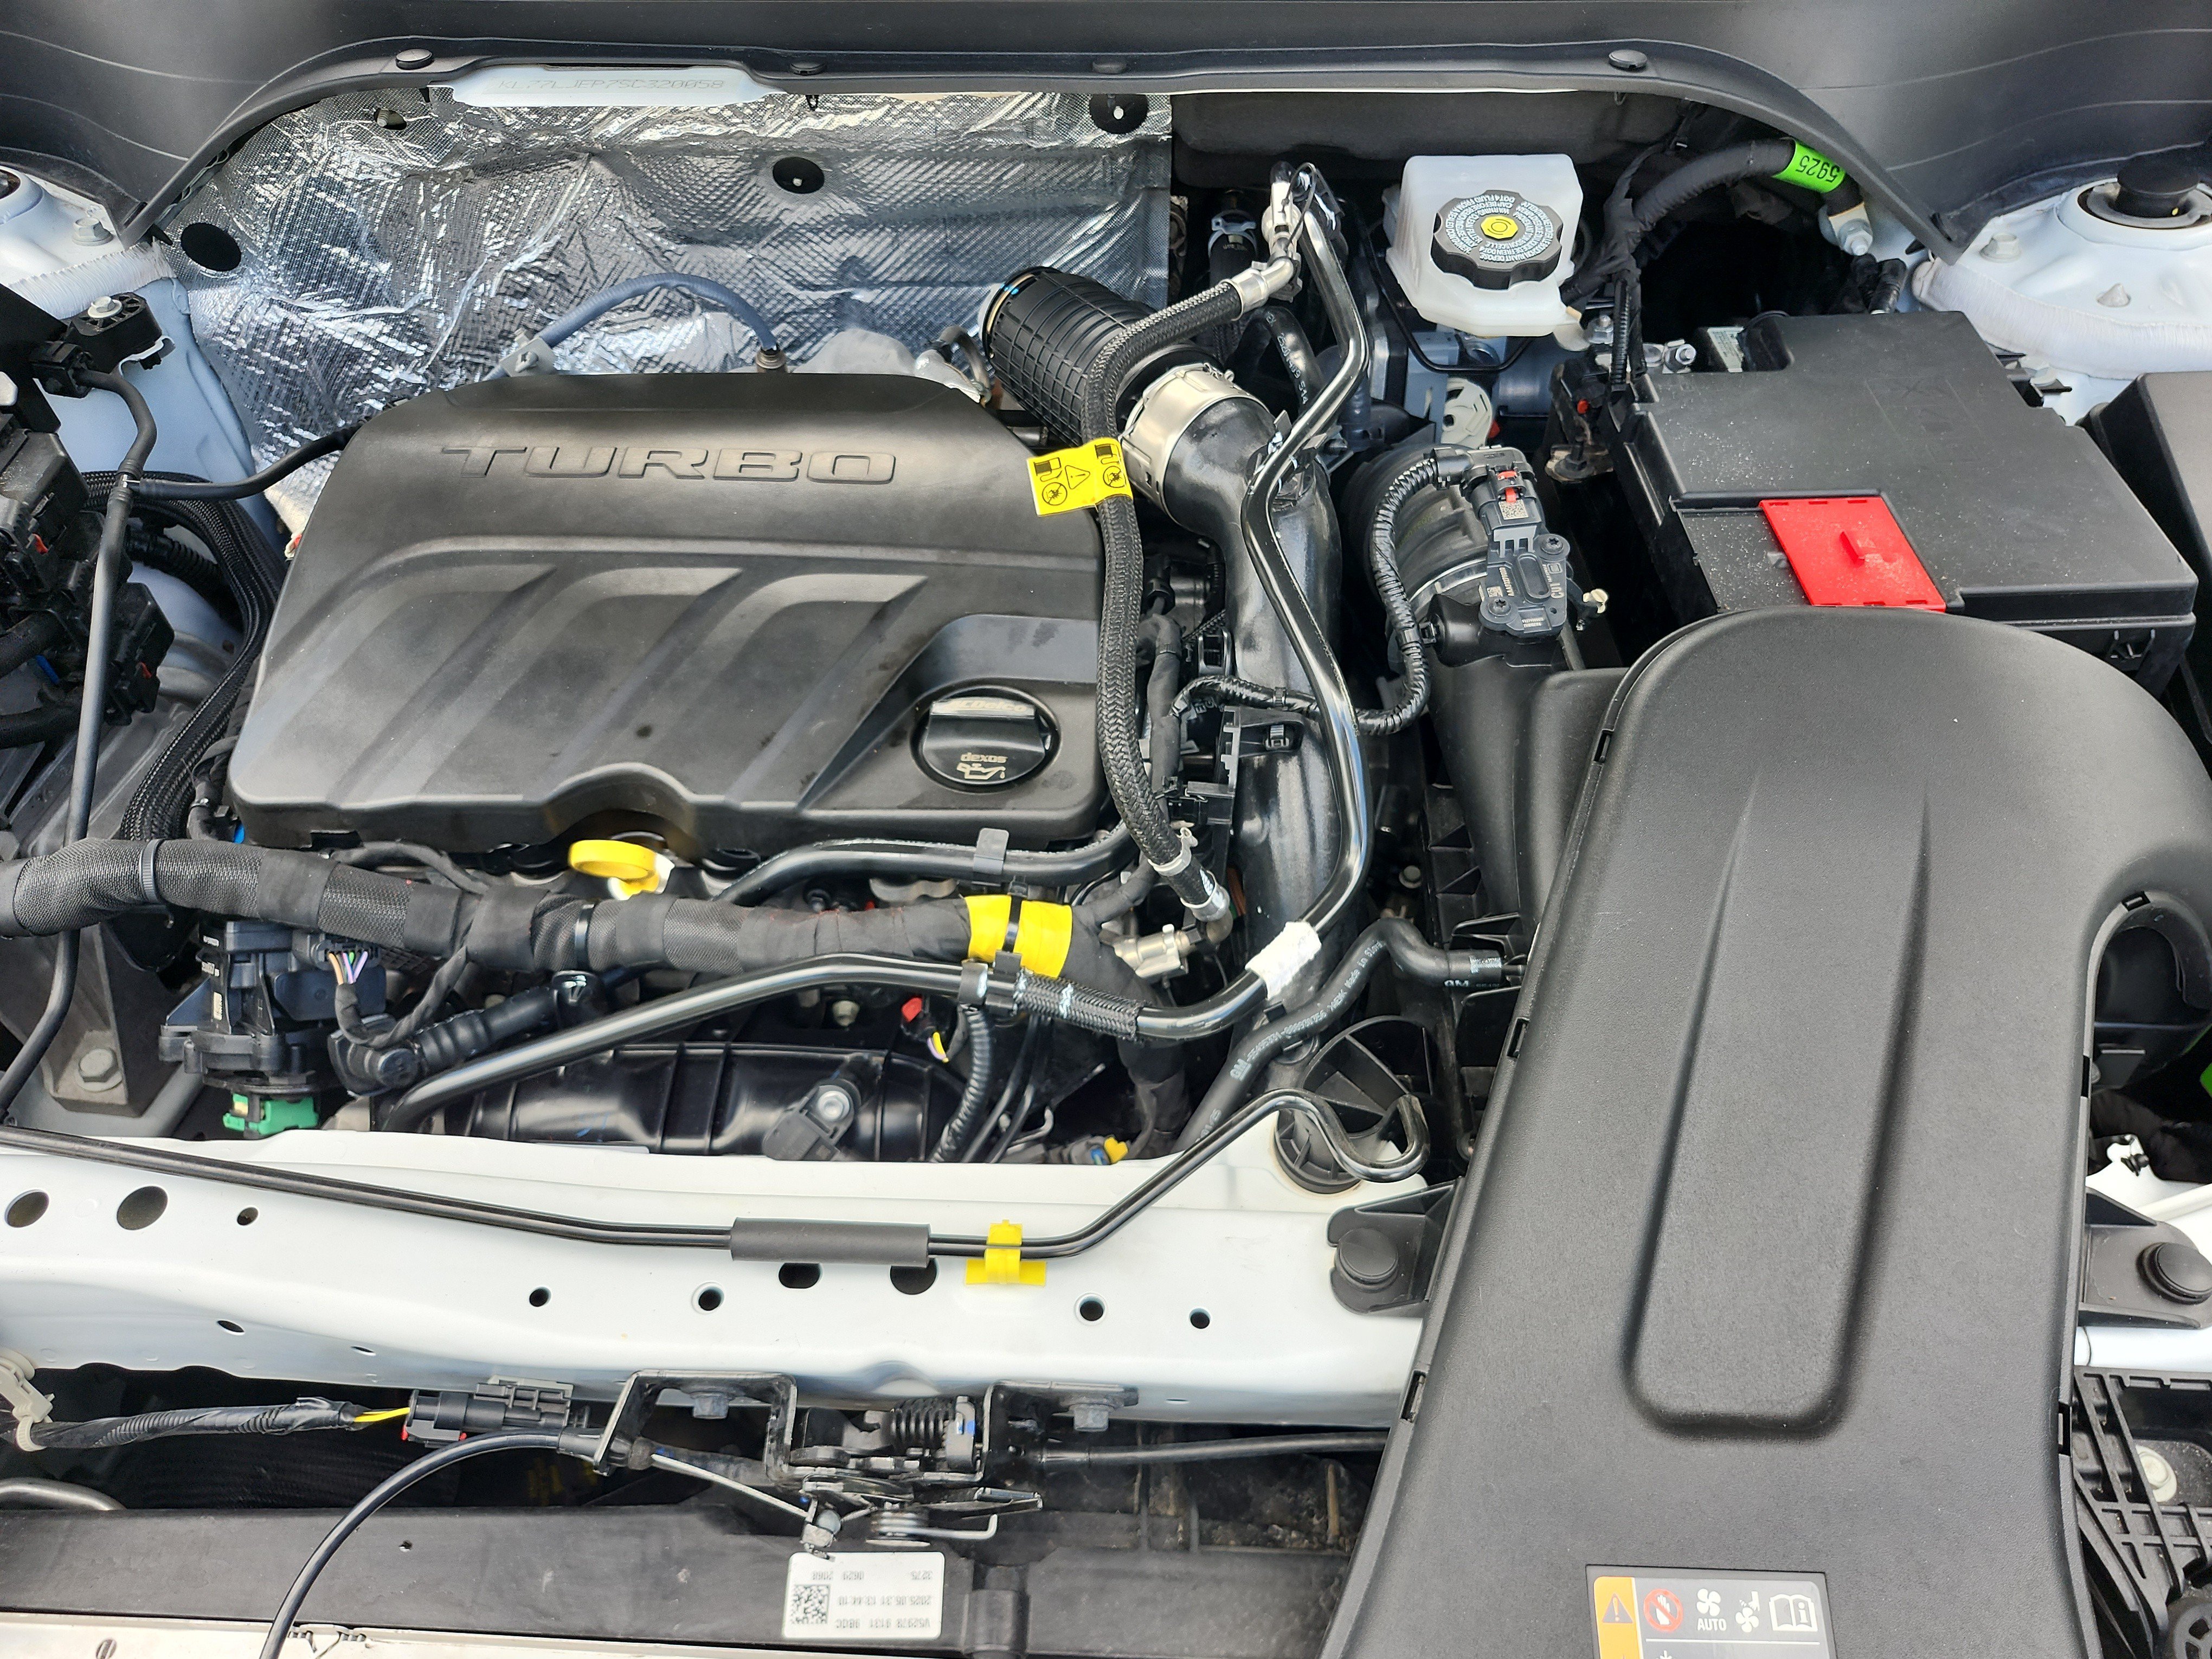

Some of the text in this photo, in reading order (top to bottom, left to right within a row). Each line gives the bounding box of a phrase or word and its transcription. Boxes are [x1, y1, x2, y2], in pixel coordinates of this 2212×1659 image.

[1795, 155, 1840, 183] 5925
[442, 446, 898, 485] TURBO
[1697, 1617, 1727, 1631] AUTO
